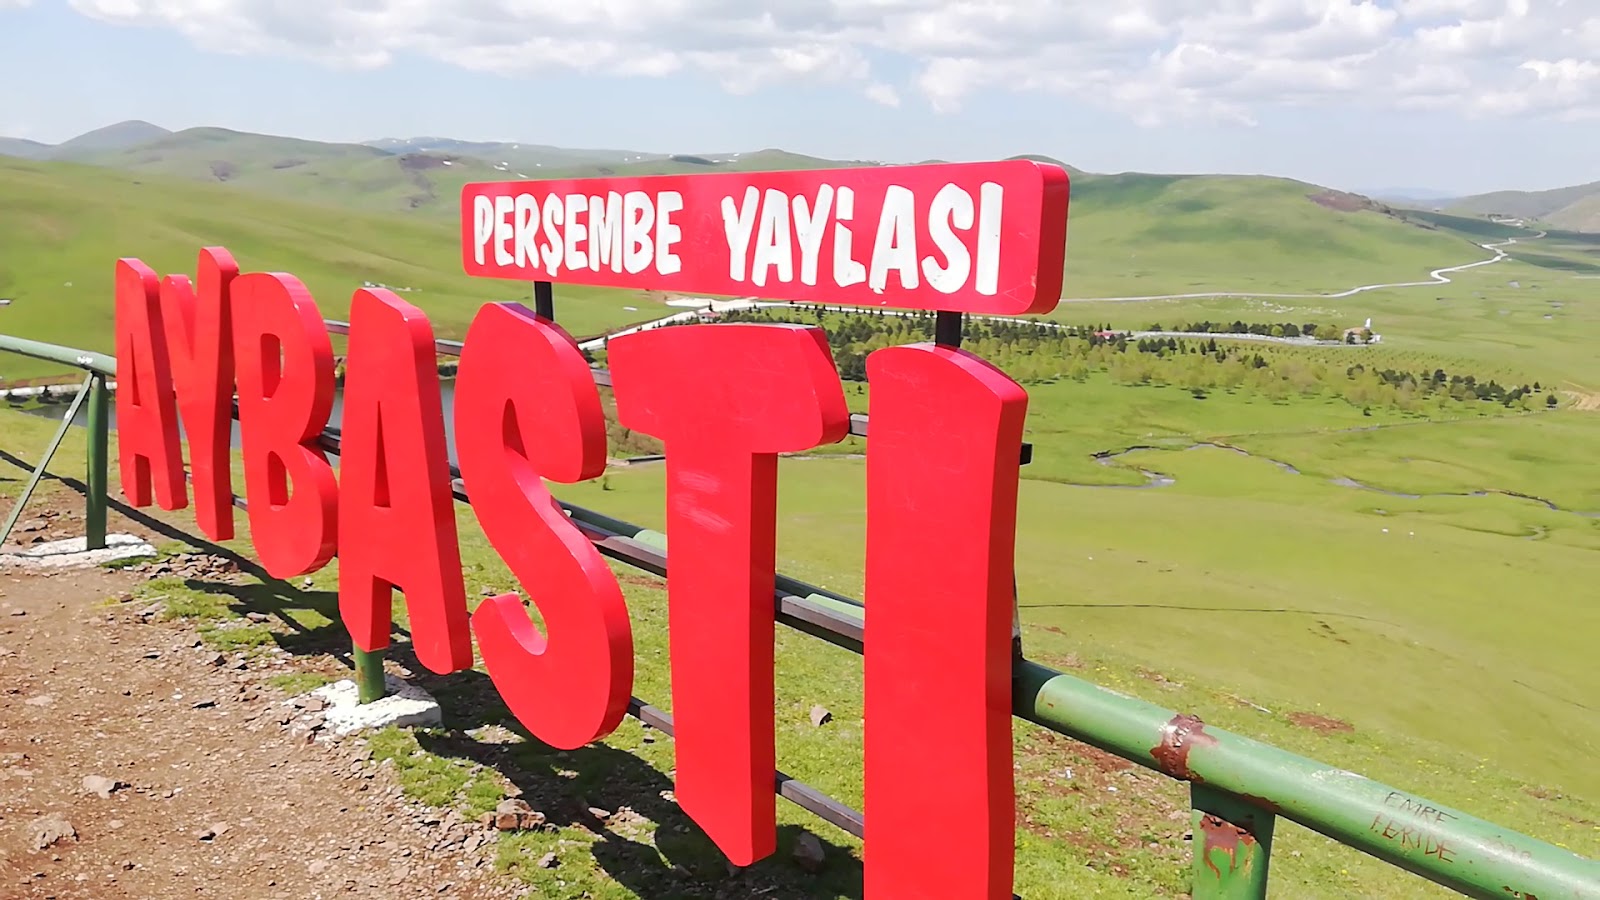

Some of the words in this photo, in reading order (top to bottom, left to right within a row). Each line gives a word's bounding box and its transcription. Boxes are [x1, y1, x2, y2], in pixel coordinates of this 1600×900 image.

[473, 190, 684, 277] PERŞEMBE
[721, 181, 1004, 296] YAYLASI
[115, 246, 1029, 900] AYBASTI
